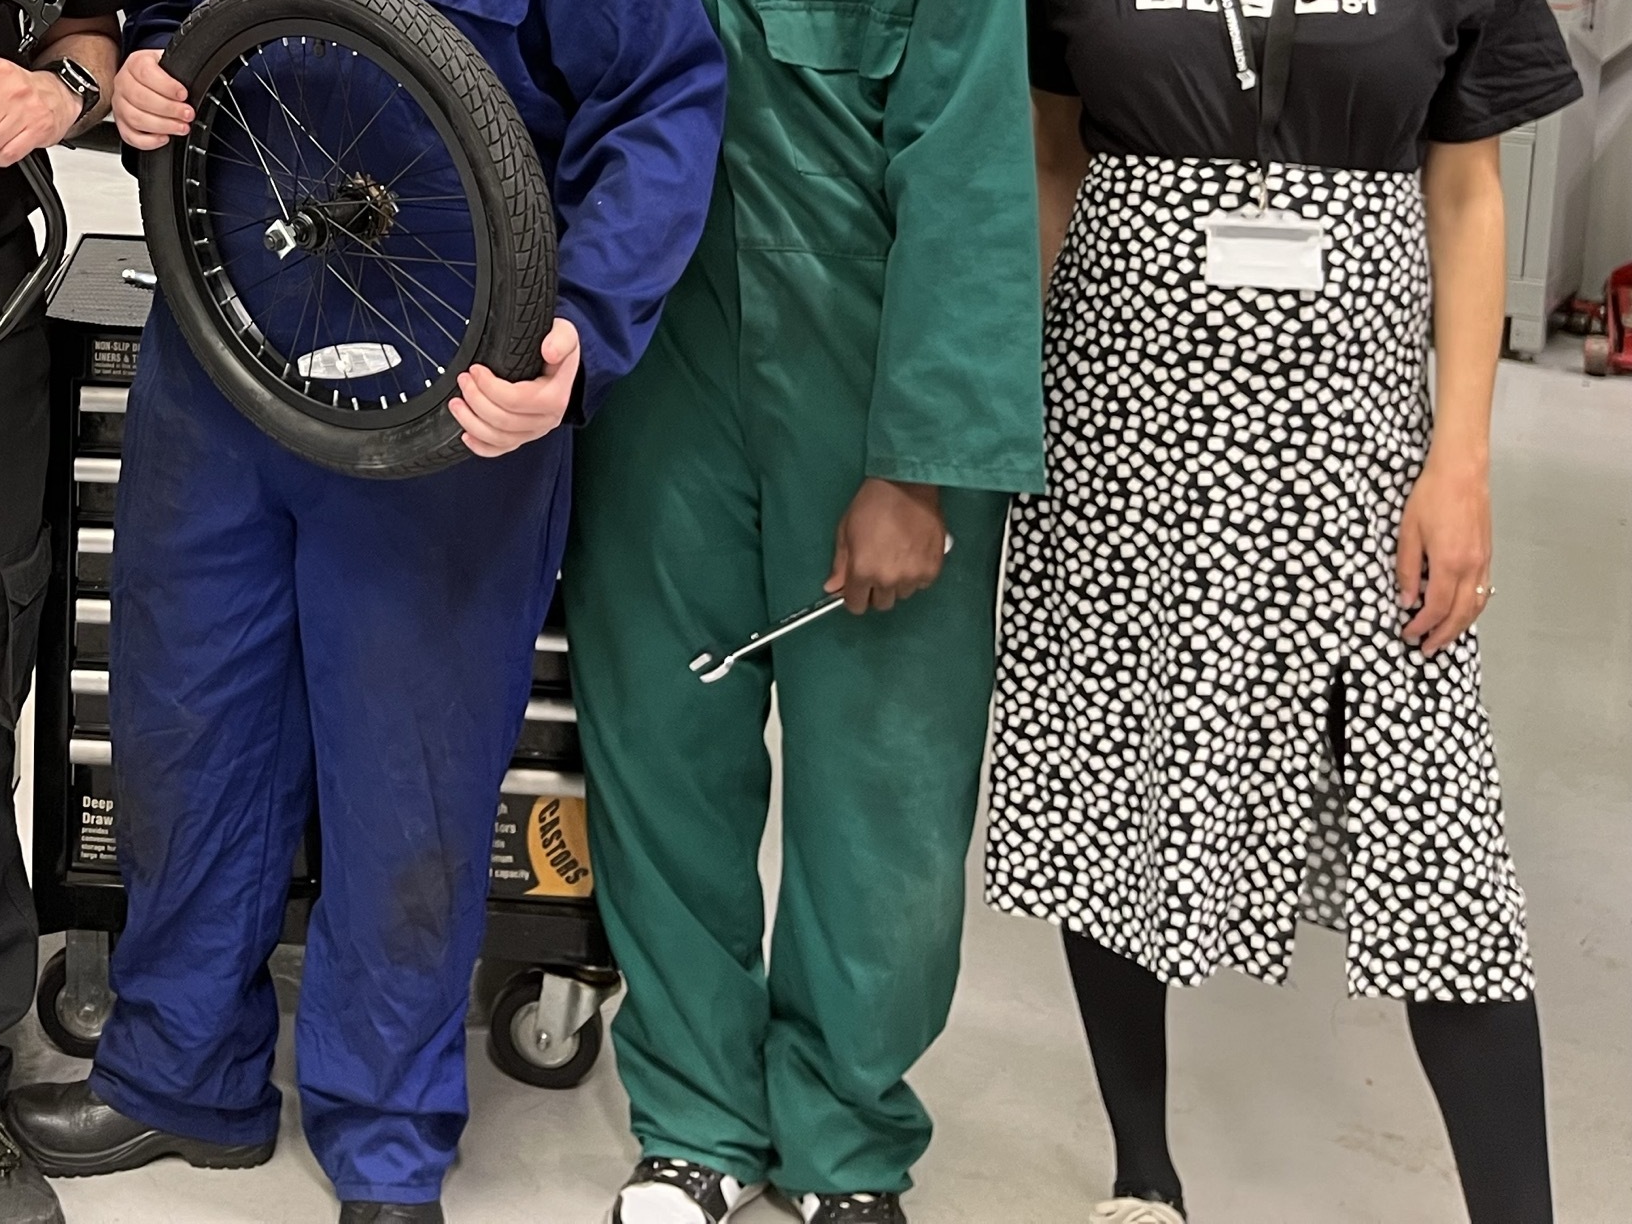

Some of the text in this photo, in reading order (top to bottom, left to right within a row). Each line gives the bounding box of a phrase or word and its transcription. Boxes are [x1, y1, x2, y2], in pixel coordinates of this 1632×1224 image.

[95, 341, 130, 351] NON-SLIP
[95, 352, 121, 363] LINERS
[82, 796, 114, 812] Deep
[82, 812, 114, 826] Draw
[538, 798, 589, 885] CASTORS
